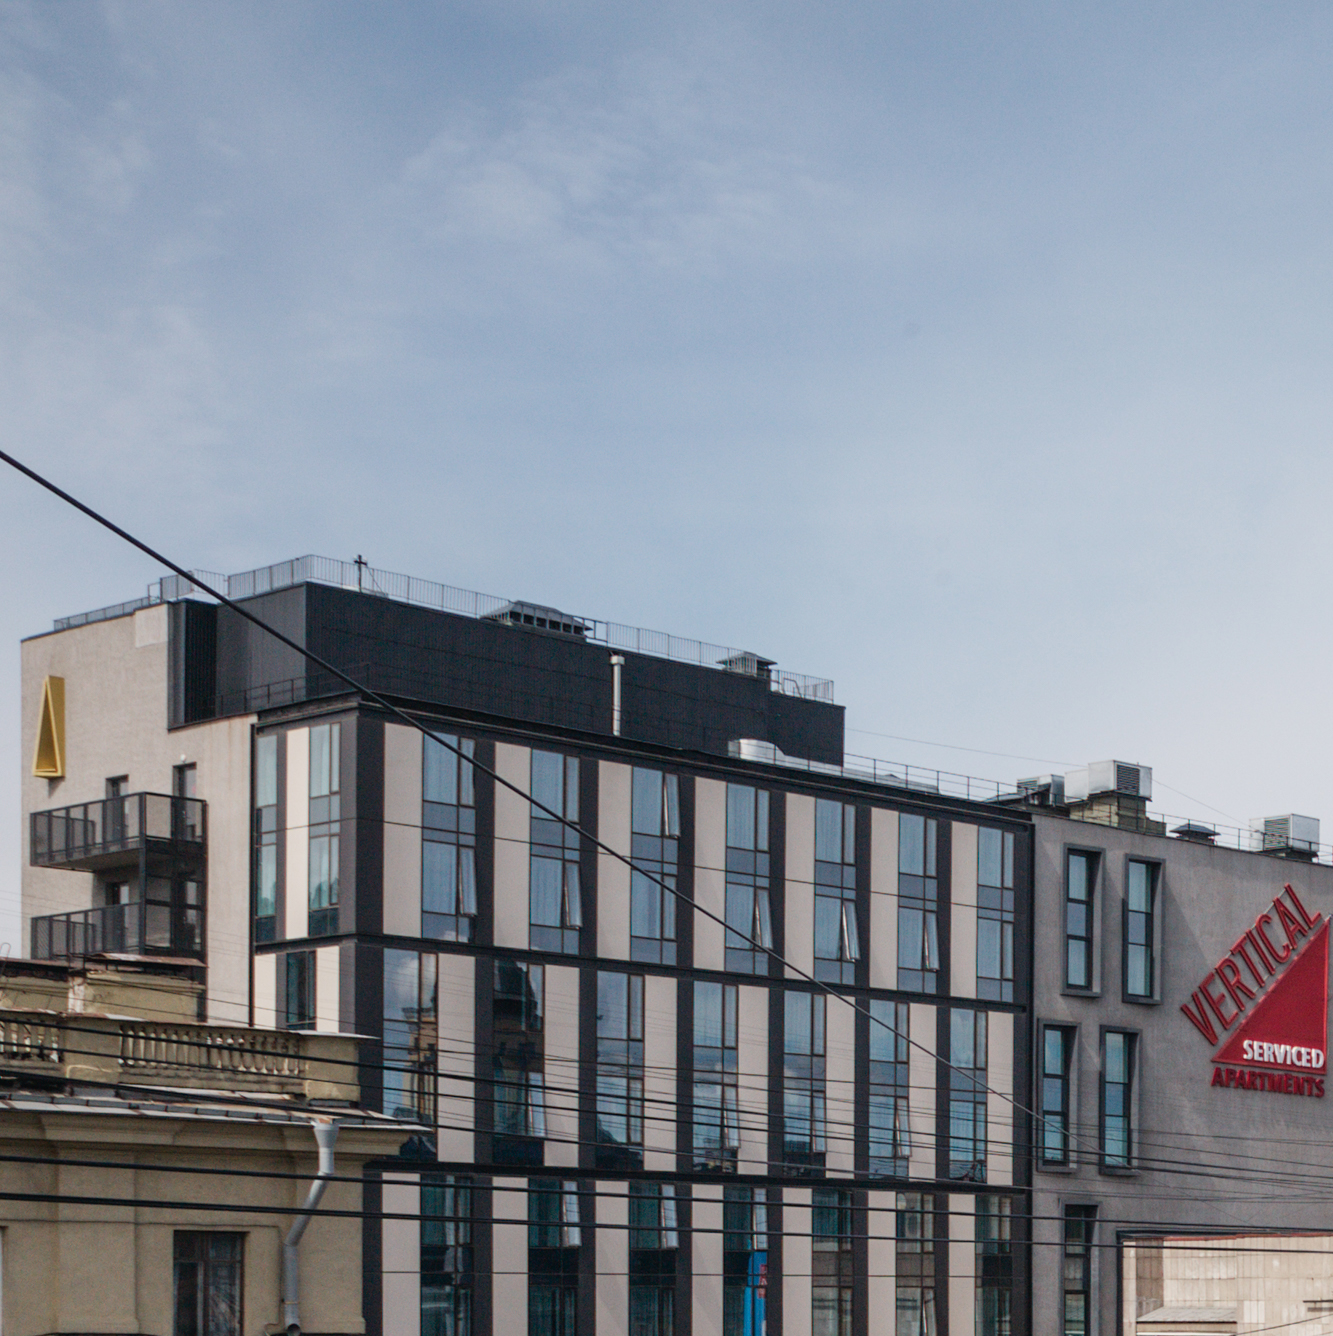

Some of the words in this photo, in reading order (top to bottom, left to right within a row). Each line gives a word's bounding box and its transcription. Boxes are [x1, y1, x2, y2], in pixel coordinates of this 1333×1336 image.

[1180, 883, 1321, 1046] VERTICAL
[1243, 1039, 1324, 1068] SERVICED
[1211, 1067, 1325, 1098] APARTMENTS
